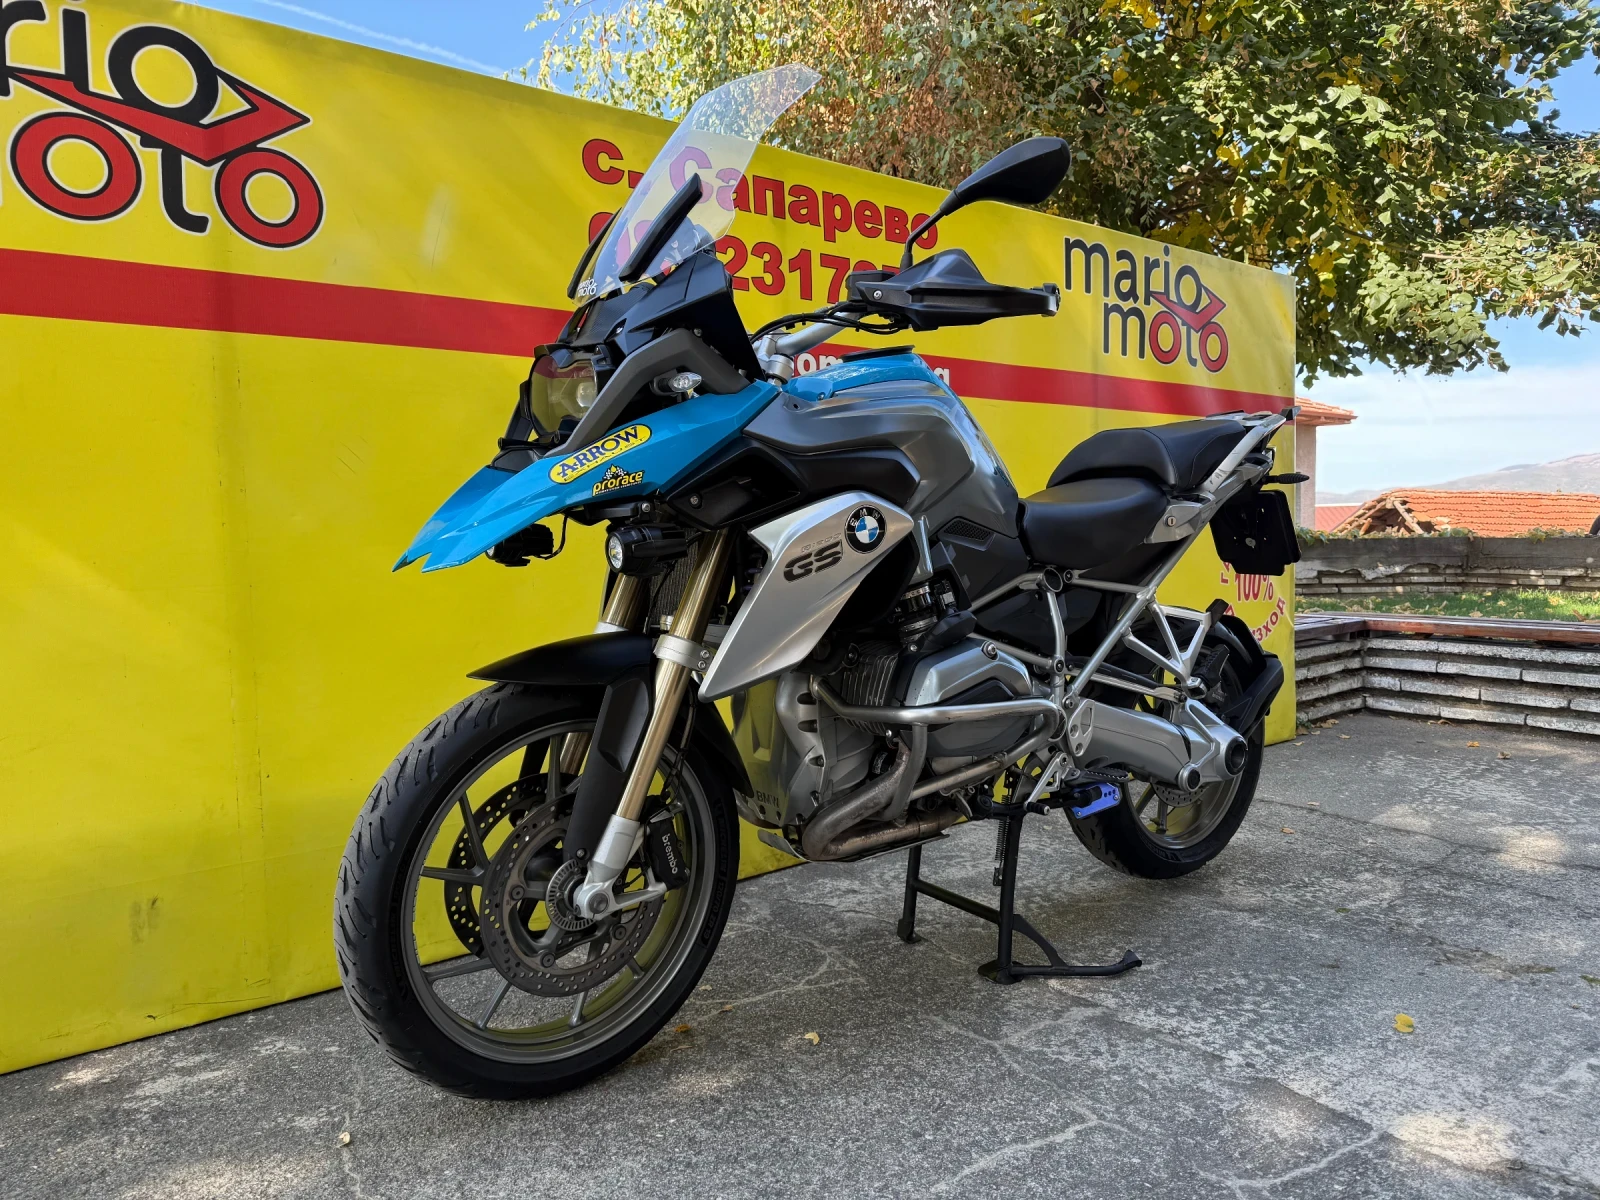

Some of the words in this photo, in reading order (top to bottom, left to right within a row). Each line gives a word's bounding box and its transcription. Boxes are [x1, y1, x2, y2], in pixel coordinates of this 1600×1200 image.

[669, 146, 938, 250] Сапарево
[1064, 237, 1202, 313] mario
[1103, 302, 1229, 373] moto
[557, 426, 640, 478] ARROW
[592, 471, 643, 496] prorace
[849, 507, 881, 528] BMW
[783, 539, 843, 583] GS
[1234, 573, 1275, 602] 100%
[756, 790, 780, 808] BMW
[661, 833, 679, 875] brembo
